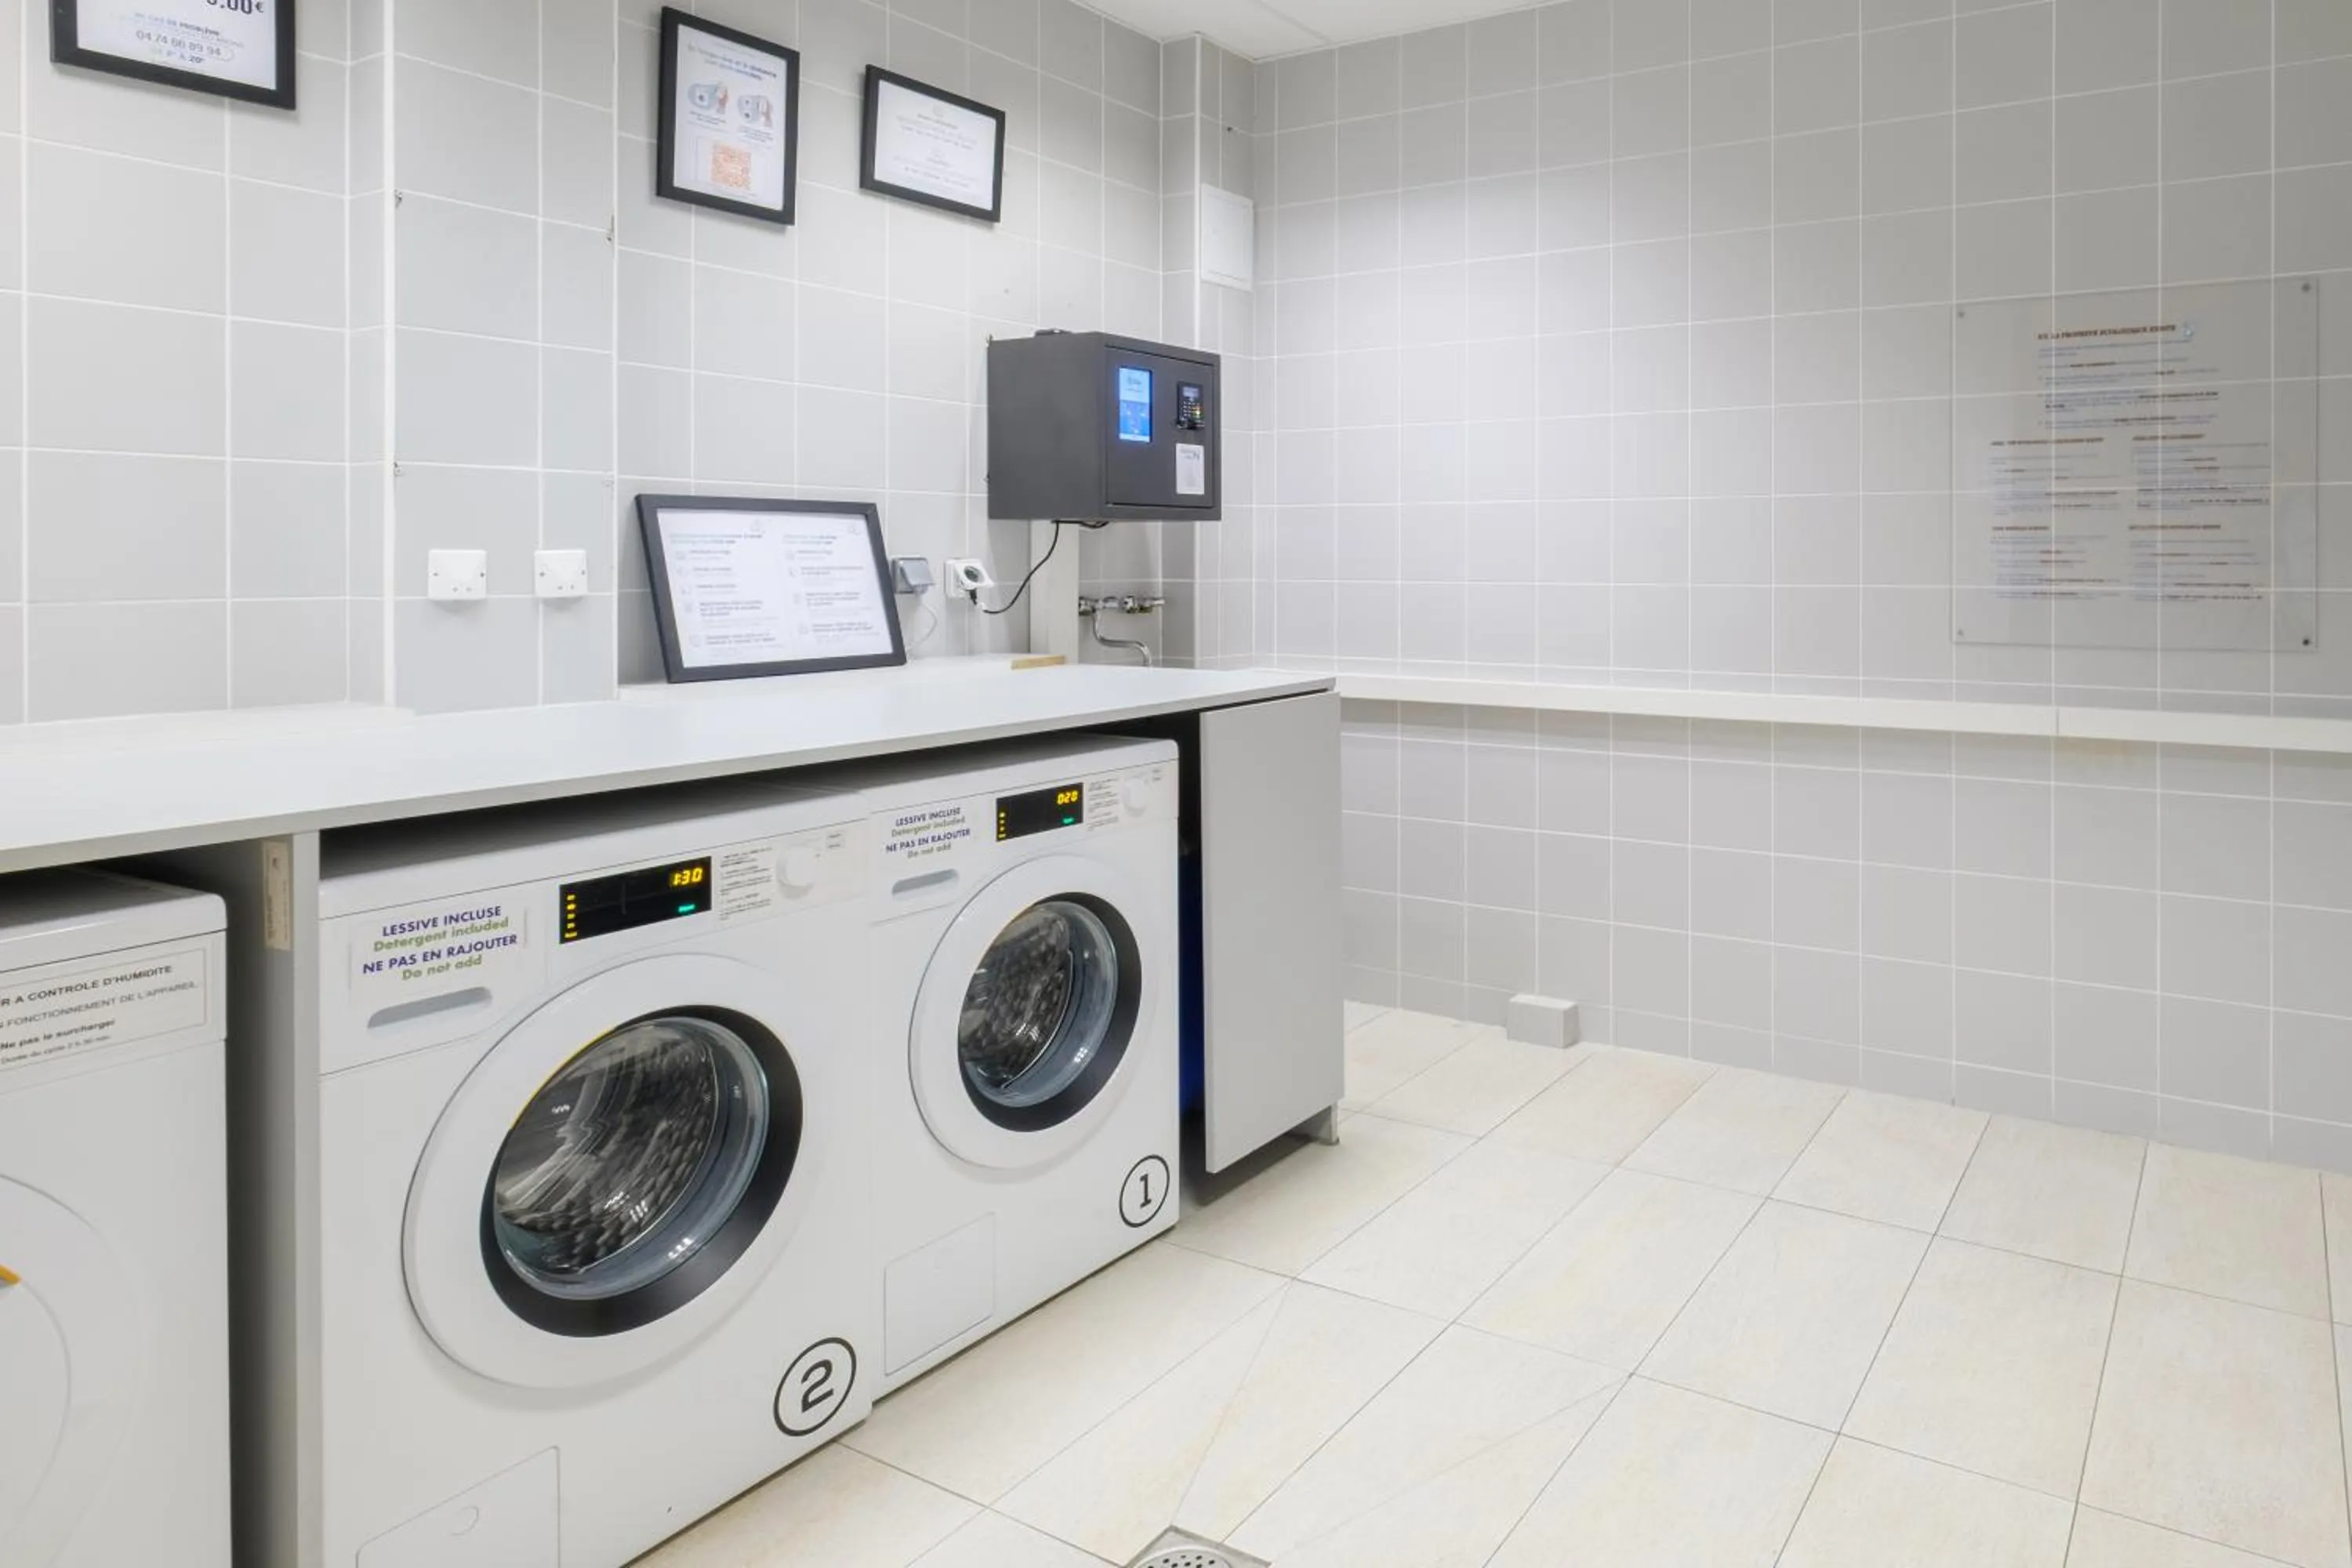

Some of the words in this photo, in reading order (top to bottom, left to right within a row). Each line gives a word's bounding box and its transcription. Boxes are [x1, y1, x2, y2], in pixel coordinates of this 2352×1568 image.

[895, 813, 926, 826] LESSIVE
[886, 844, 897, 853] NE
[900, 840, 916, 851] PAS
[373, 929, 447, 952] Detergent
[452, 916, 509, 938] included
[383, 916, 438, 936] LESSIVE
[444, 906, 501, 925] INCLUSE
[363, 960, 383, 974] NE
[389, 953, 417, 969] PAS
[423, 949, 441, 962] EN
[447, 935, 517, 956] RAJOUTER
[401, 968, 423, 981] Do
[427, 964, 450, 976] not
[455, 954, 482, 970] add
[15, 995, 24, 1004] A
[27, 980, 100, 1001] CONTROLE
[103, 965, 172, 985] D'HUMIDITE
[7, 998, 116, 1026] FONCTIONNEMENT
[120, 993, 135, 1004] DE
[1140, 1173, 1152, 1208] 1
[801, 1359, 834, 1414] 2
